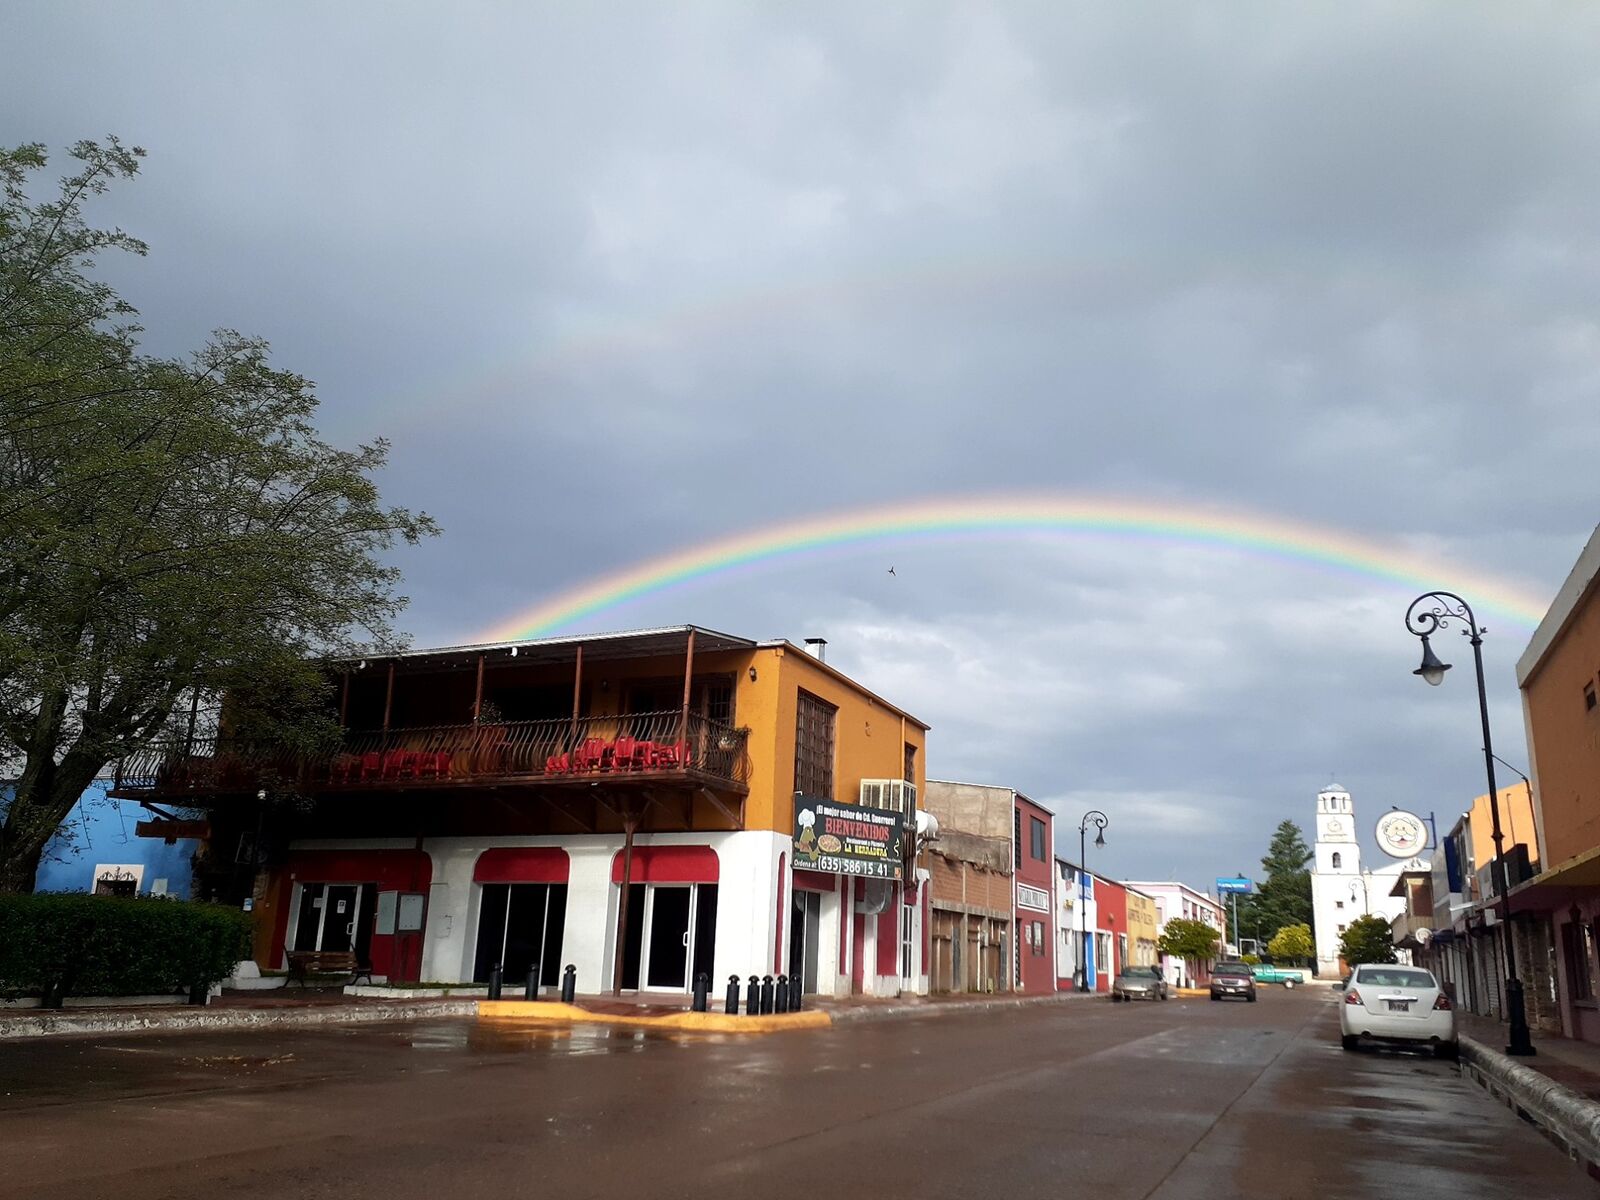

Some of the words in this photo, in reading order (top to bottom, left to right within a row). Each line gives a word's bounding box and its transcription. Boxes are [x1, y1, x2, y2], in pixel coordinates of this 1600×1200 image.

[855, 811, 862, 821] de
[825, 817, 890, 841] BIENVENIDOS
[793, 859, 811, 868] Ordena
[818, 855, 842, 873] (635)
[843, 859, 861, 873] 586
[863, 862, 874, 875] 15
[877, 863, 888, 877] 41
